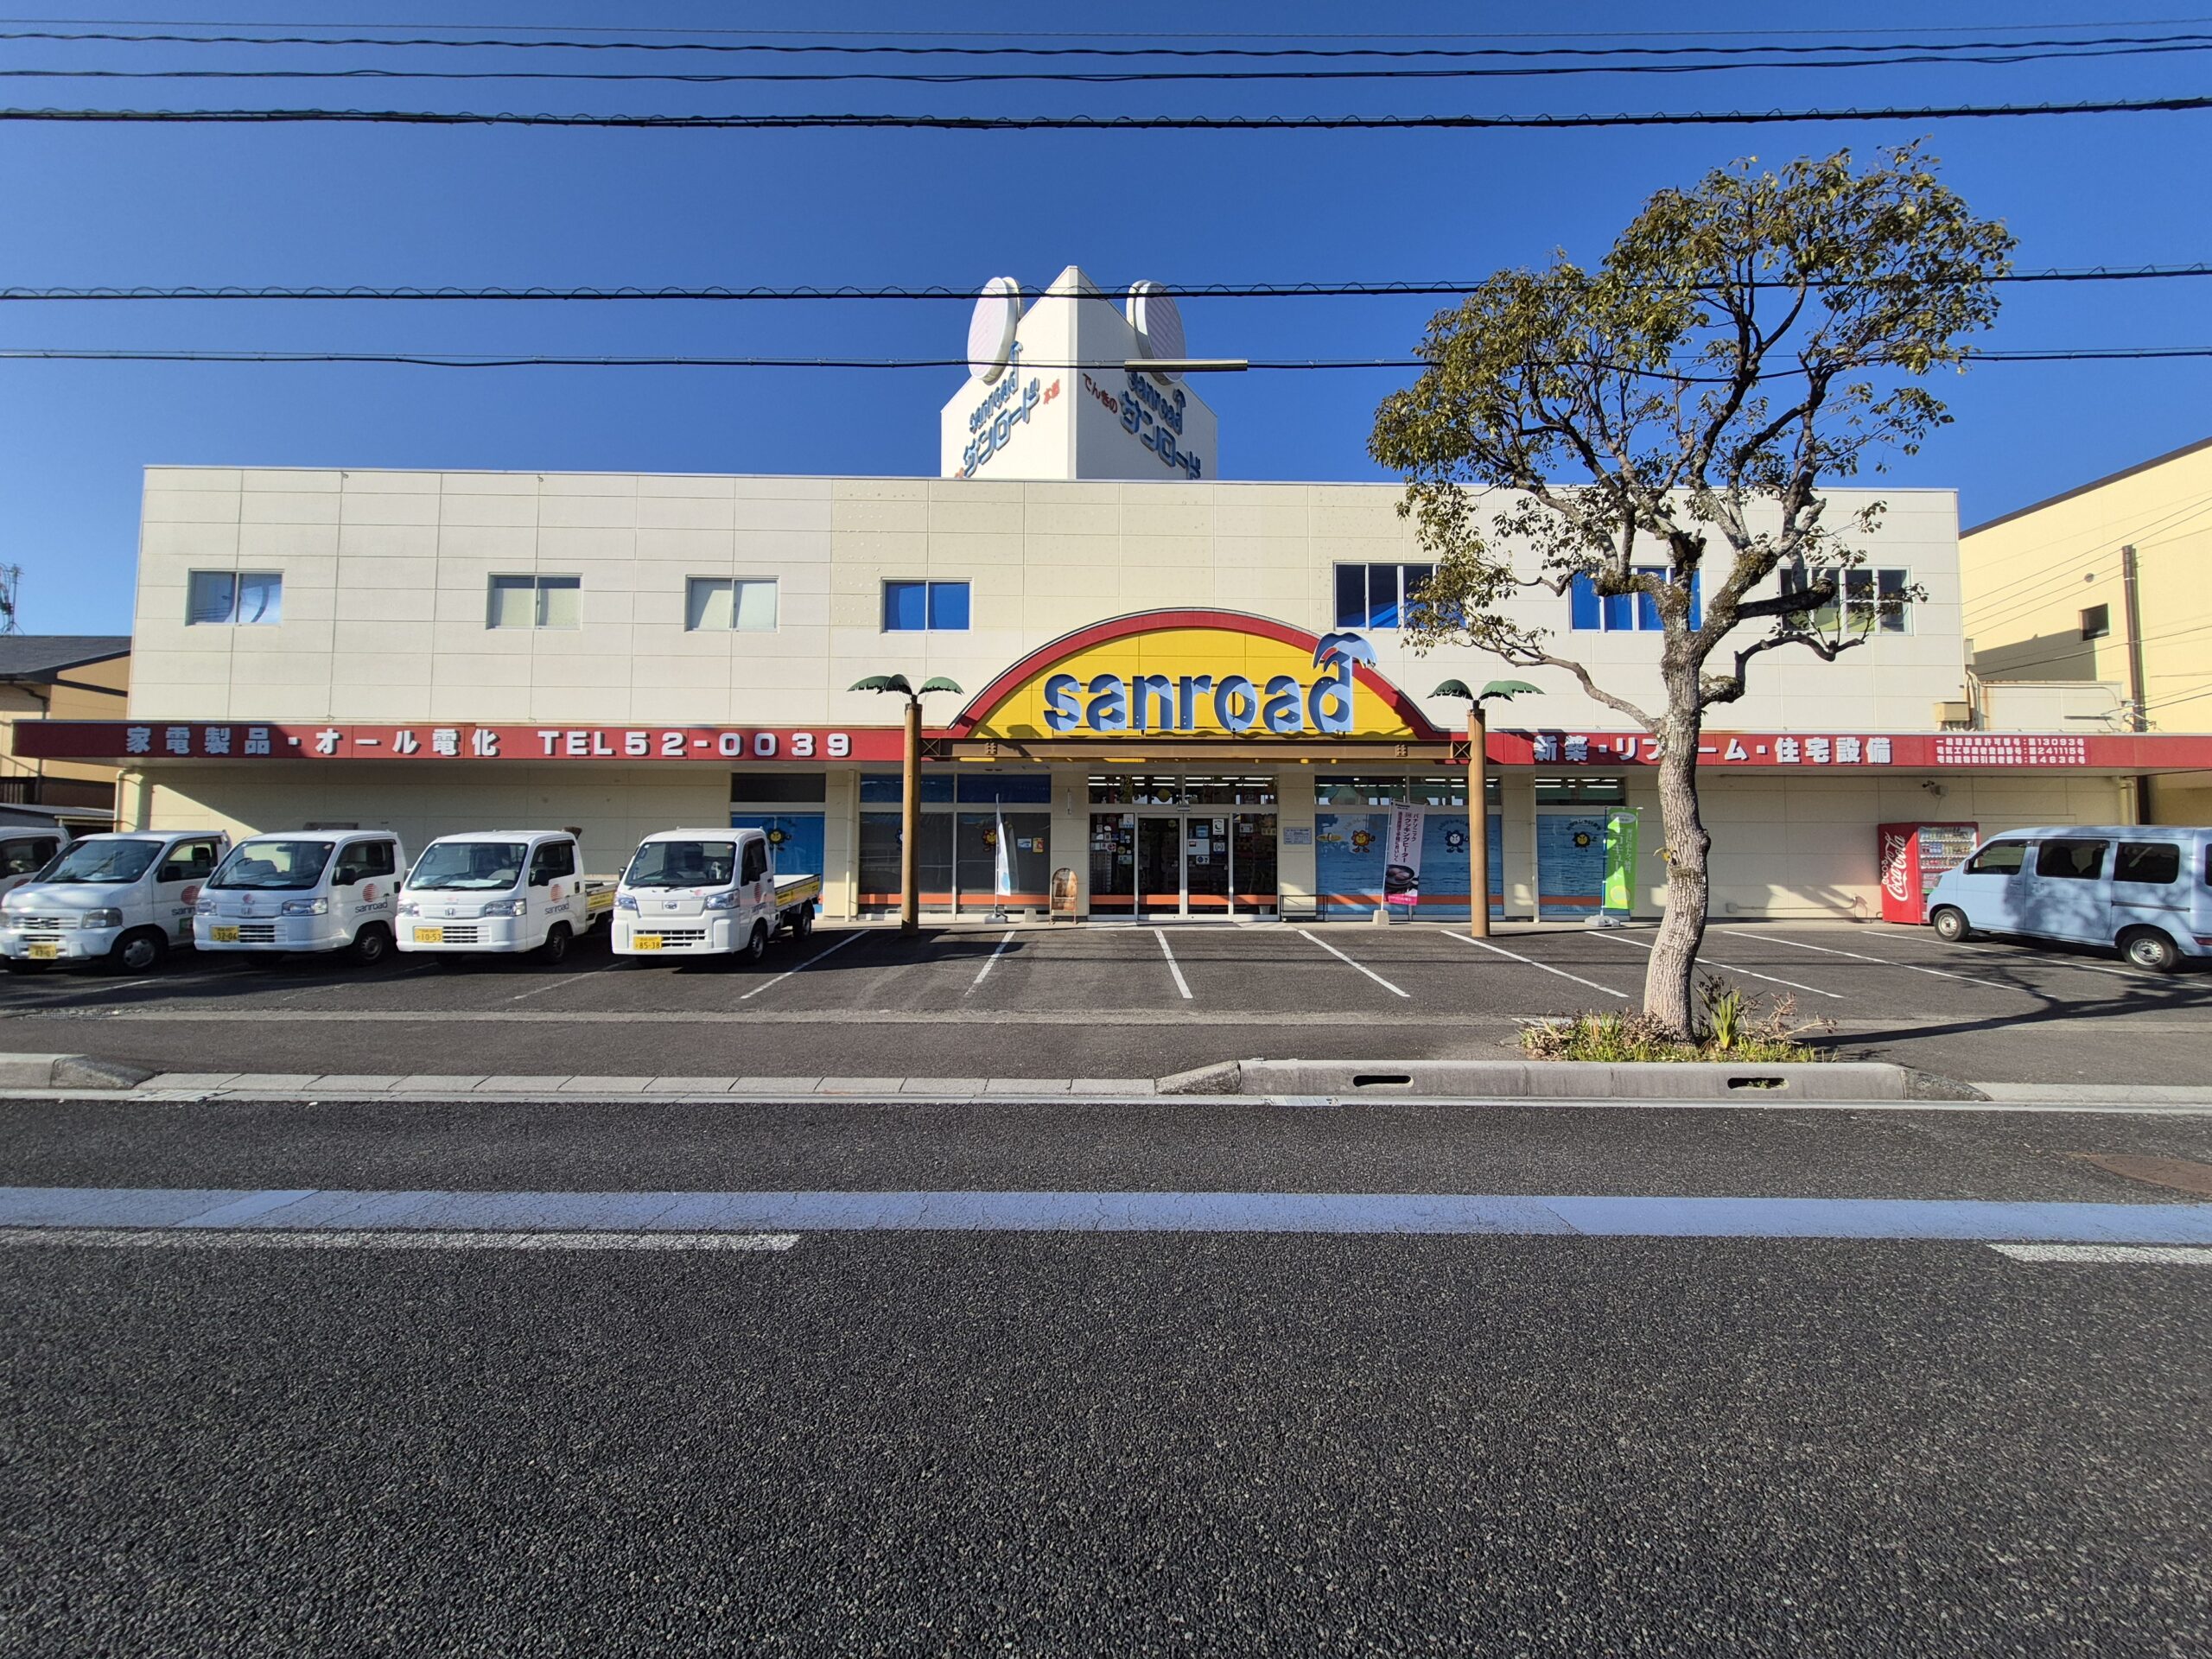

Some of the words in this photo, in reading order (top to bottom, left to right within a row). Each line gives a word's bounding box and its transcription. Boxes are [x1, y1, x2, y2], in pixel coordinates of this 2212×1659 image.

[963, 378, 1039, 478] サンロード
[1118, 391, 1201, 480] サンロード
[1043, 632, 1376, 733] sanroad
[126, 727, 500, 755] 家電製品・オール電化
[537, 730, 853, 757] TEL52-0039
[1533, 735, 1892, 764] 新築・リフーム・住宅設備
[1885, 831, 1908, 901] Coca-Cola
[355, 893, 389, 913] sanroad
[544, 895, 569, 915] sanroad
